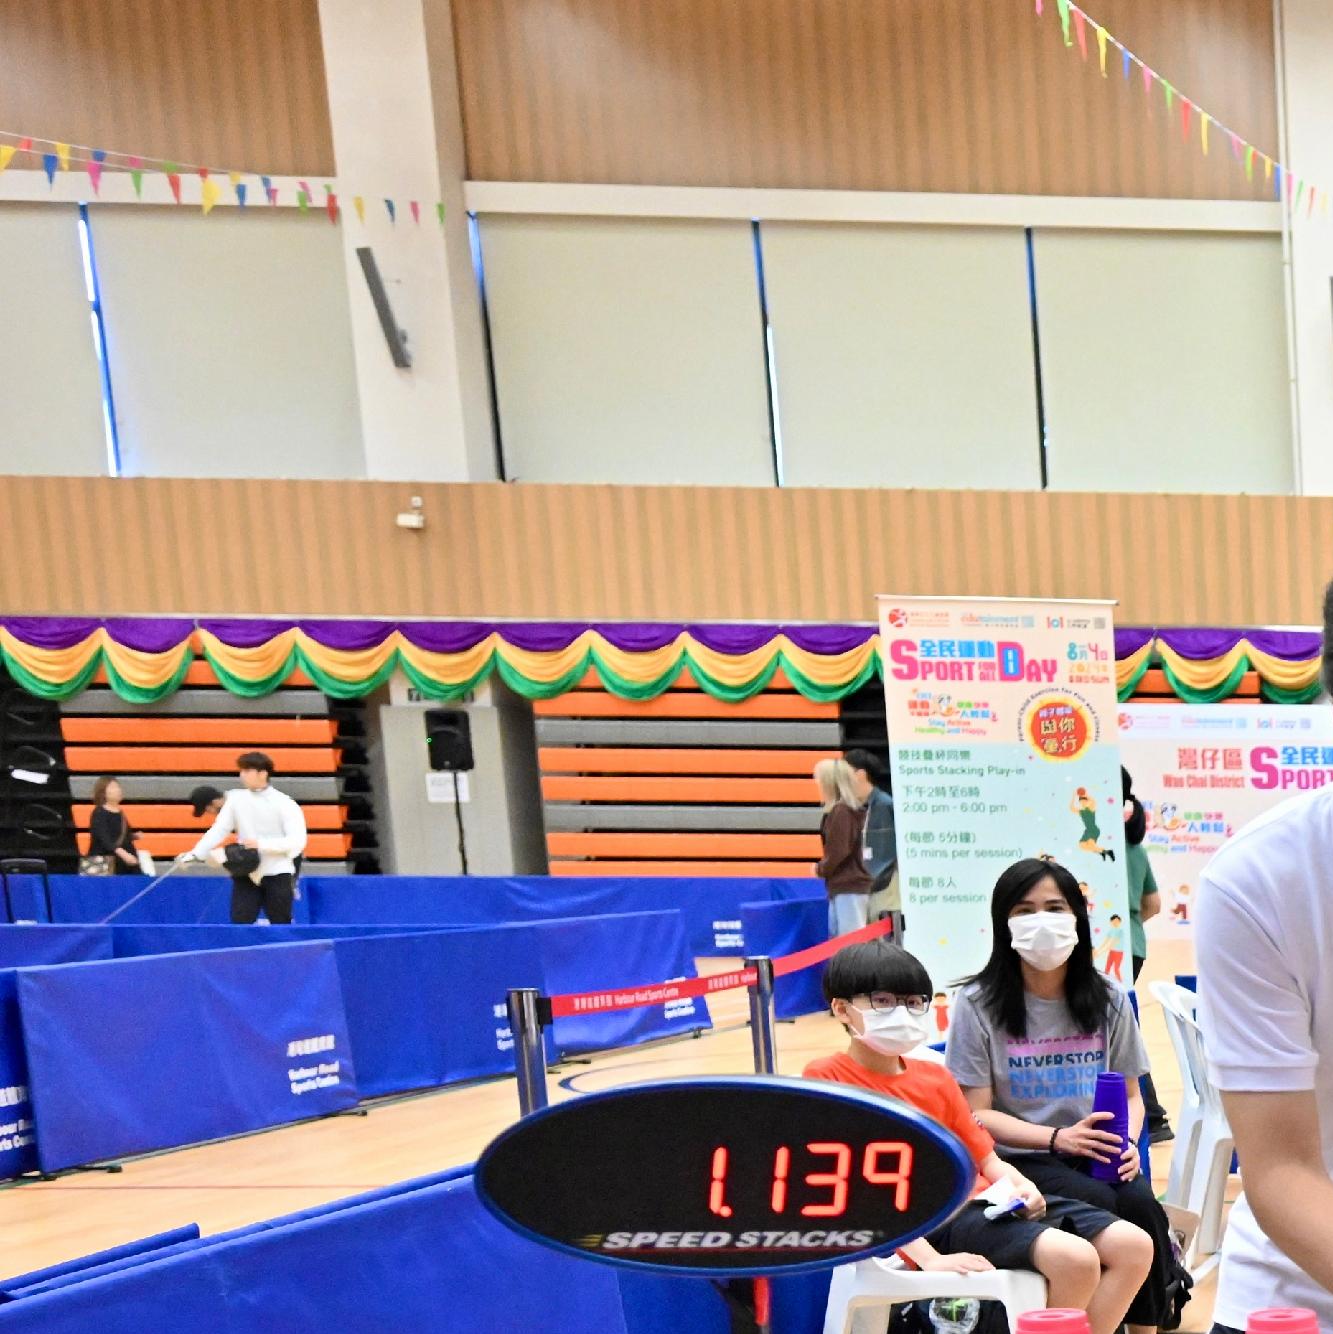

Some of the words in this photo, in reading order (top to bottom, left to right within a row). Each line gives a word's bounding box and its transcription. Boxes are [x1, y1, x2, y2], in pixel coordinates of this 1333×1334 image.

[890, 639, 976, 682] SPORT
[997, 641, 1058, 683] DAY
[1178, 748, 1243, 770] 灣仔區
[899, 765, 934, 776] Sports
[937, 766, 983, 777] Stacking
[987, 766, 1026, 777] Play-in
[1186, 775, 1210, 788] Chai
[1210, 775, 1246, 789] District
[904, 802, 928, 813] 2:00
[931, 805, 950, 814] pm
[960, 802, 986, 813] 6:00
[989, 805, 1008, 815] pm
[602, 1231, 734, 1250] SPEED
[734, 1229, 874, 1248] STACKS
